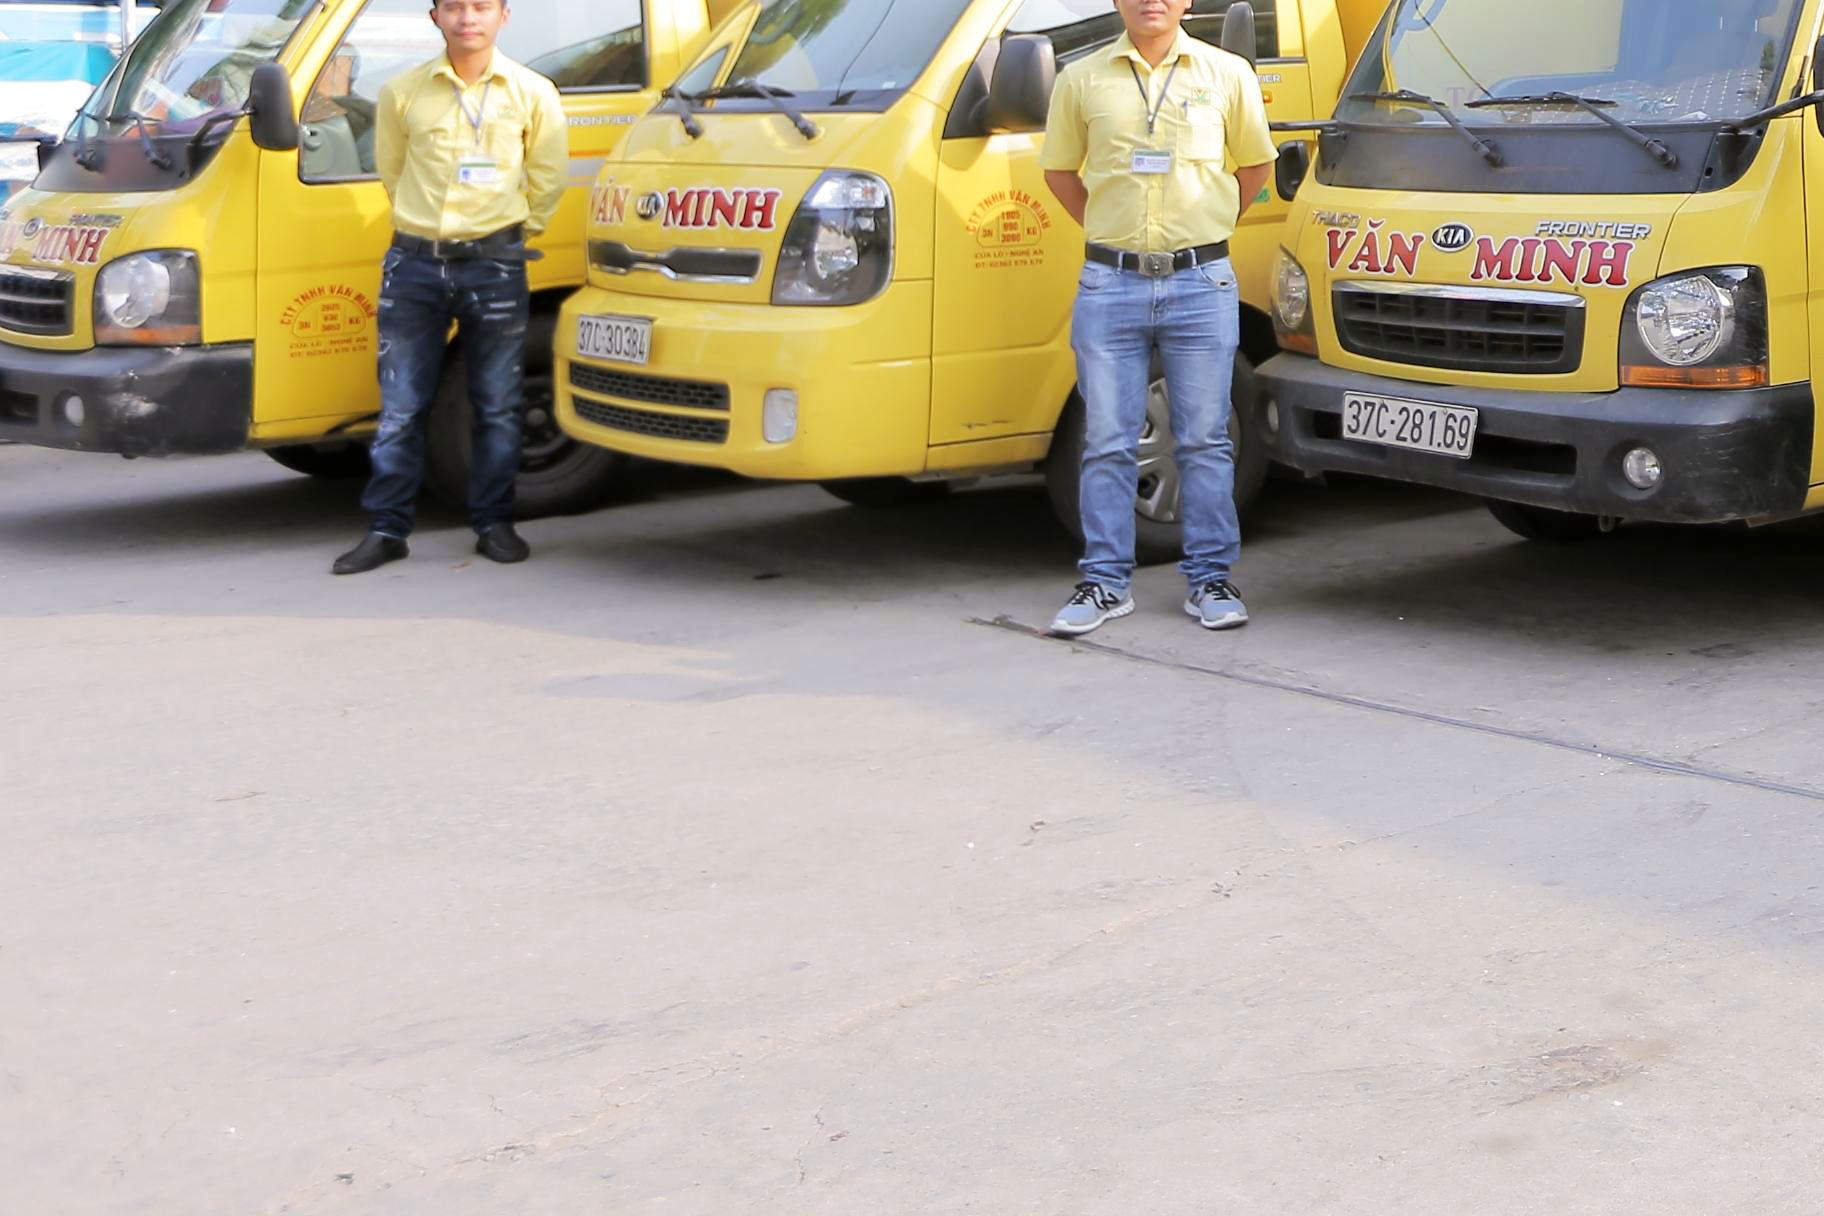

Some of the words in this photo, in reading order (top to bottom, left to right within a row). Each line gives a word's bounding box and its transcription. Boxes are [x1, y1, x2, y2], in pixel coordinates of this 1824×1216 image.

[662, 189, 781, 229] MINH
[32, 226, 110, 263] MINH
[1535, 221, 1652, 241] FRONTIER
[1326, 218, 1425, 275] VĂN
[1436, 228, 1466, 245] KIA
[1471, 238, 1636, 285] MINH
[1346, 400, 1472, 452] 37C-281.69
